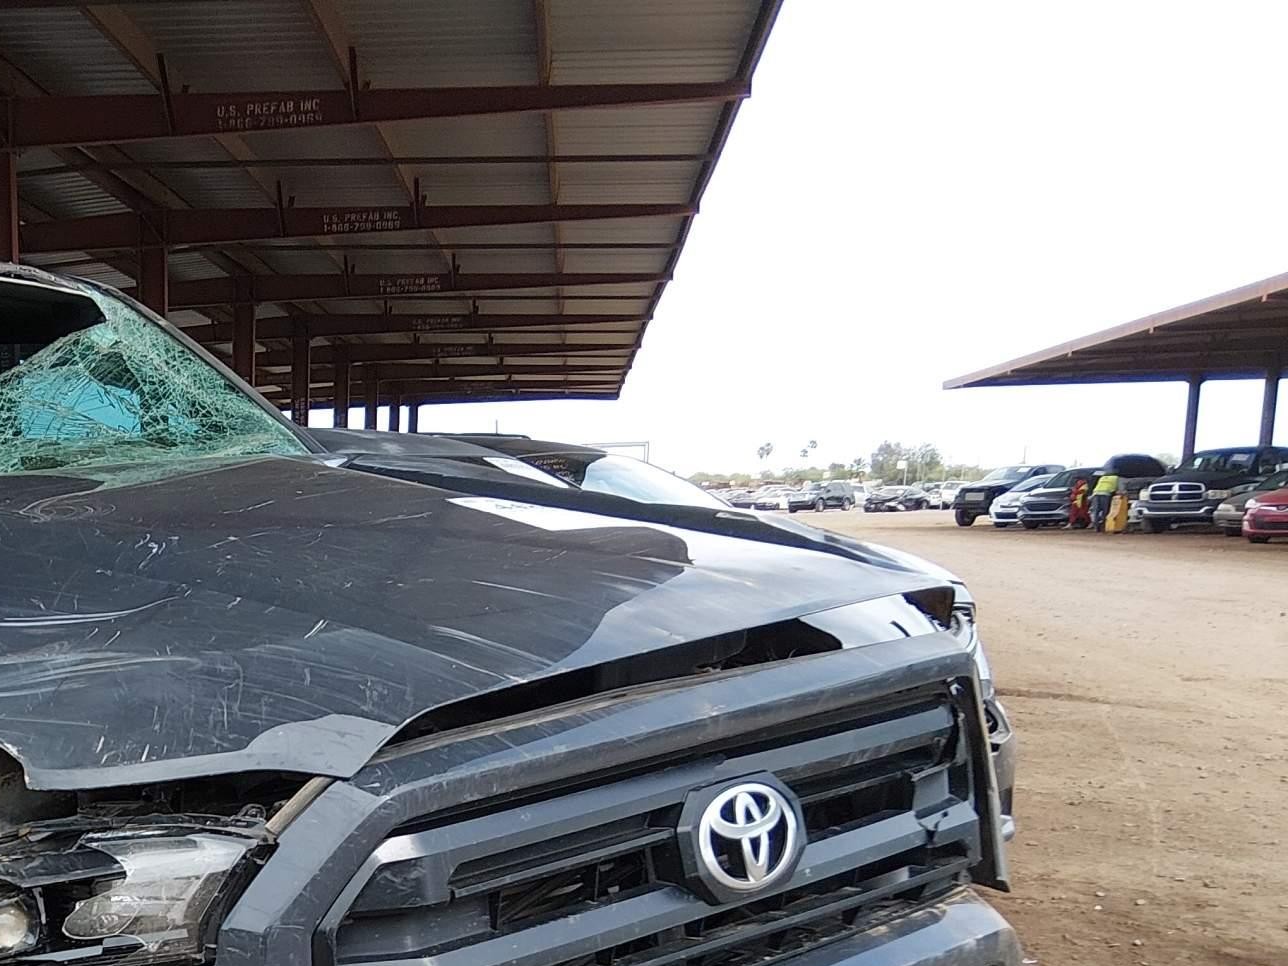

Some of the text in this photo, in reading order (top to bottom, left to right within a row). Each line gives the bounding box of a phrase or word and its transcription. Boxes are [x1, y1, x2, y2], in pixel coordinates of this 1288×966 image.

[216, 105, 240, 118] U.S.
[246, 100, 294, 116] PREFAB
[344, 211, 380, 222] PREFAB
